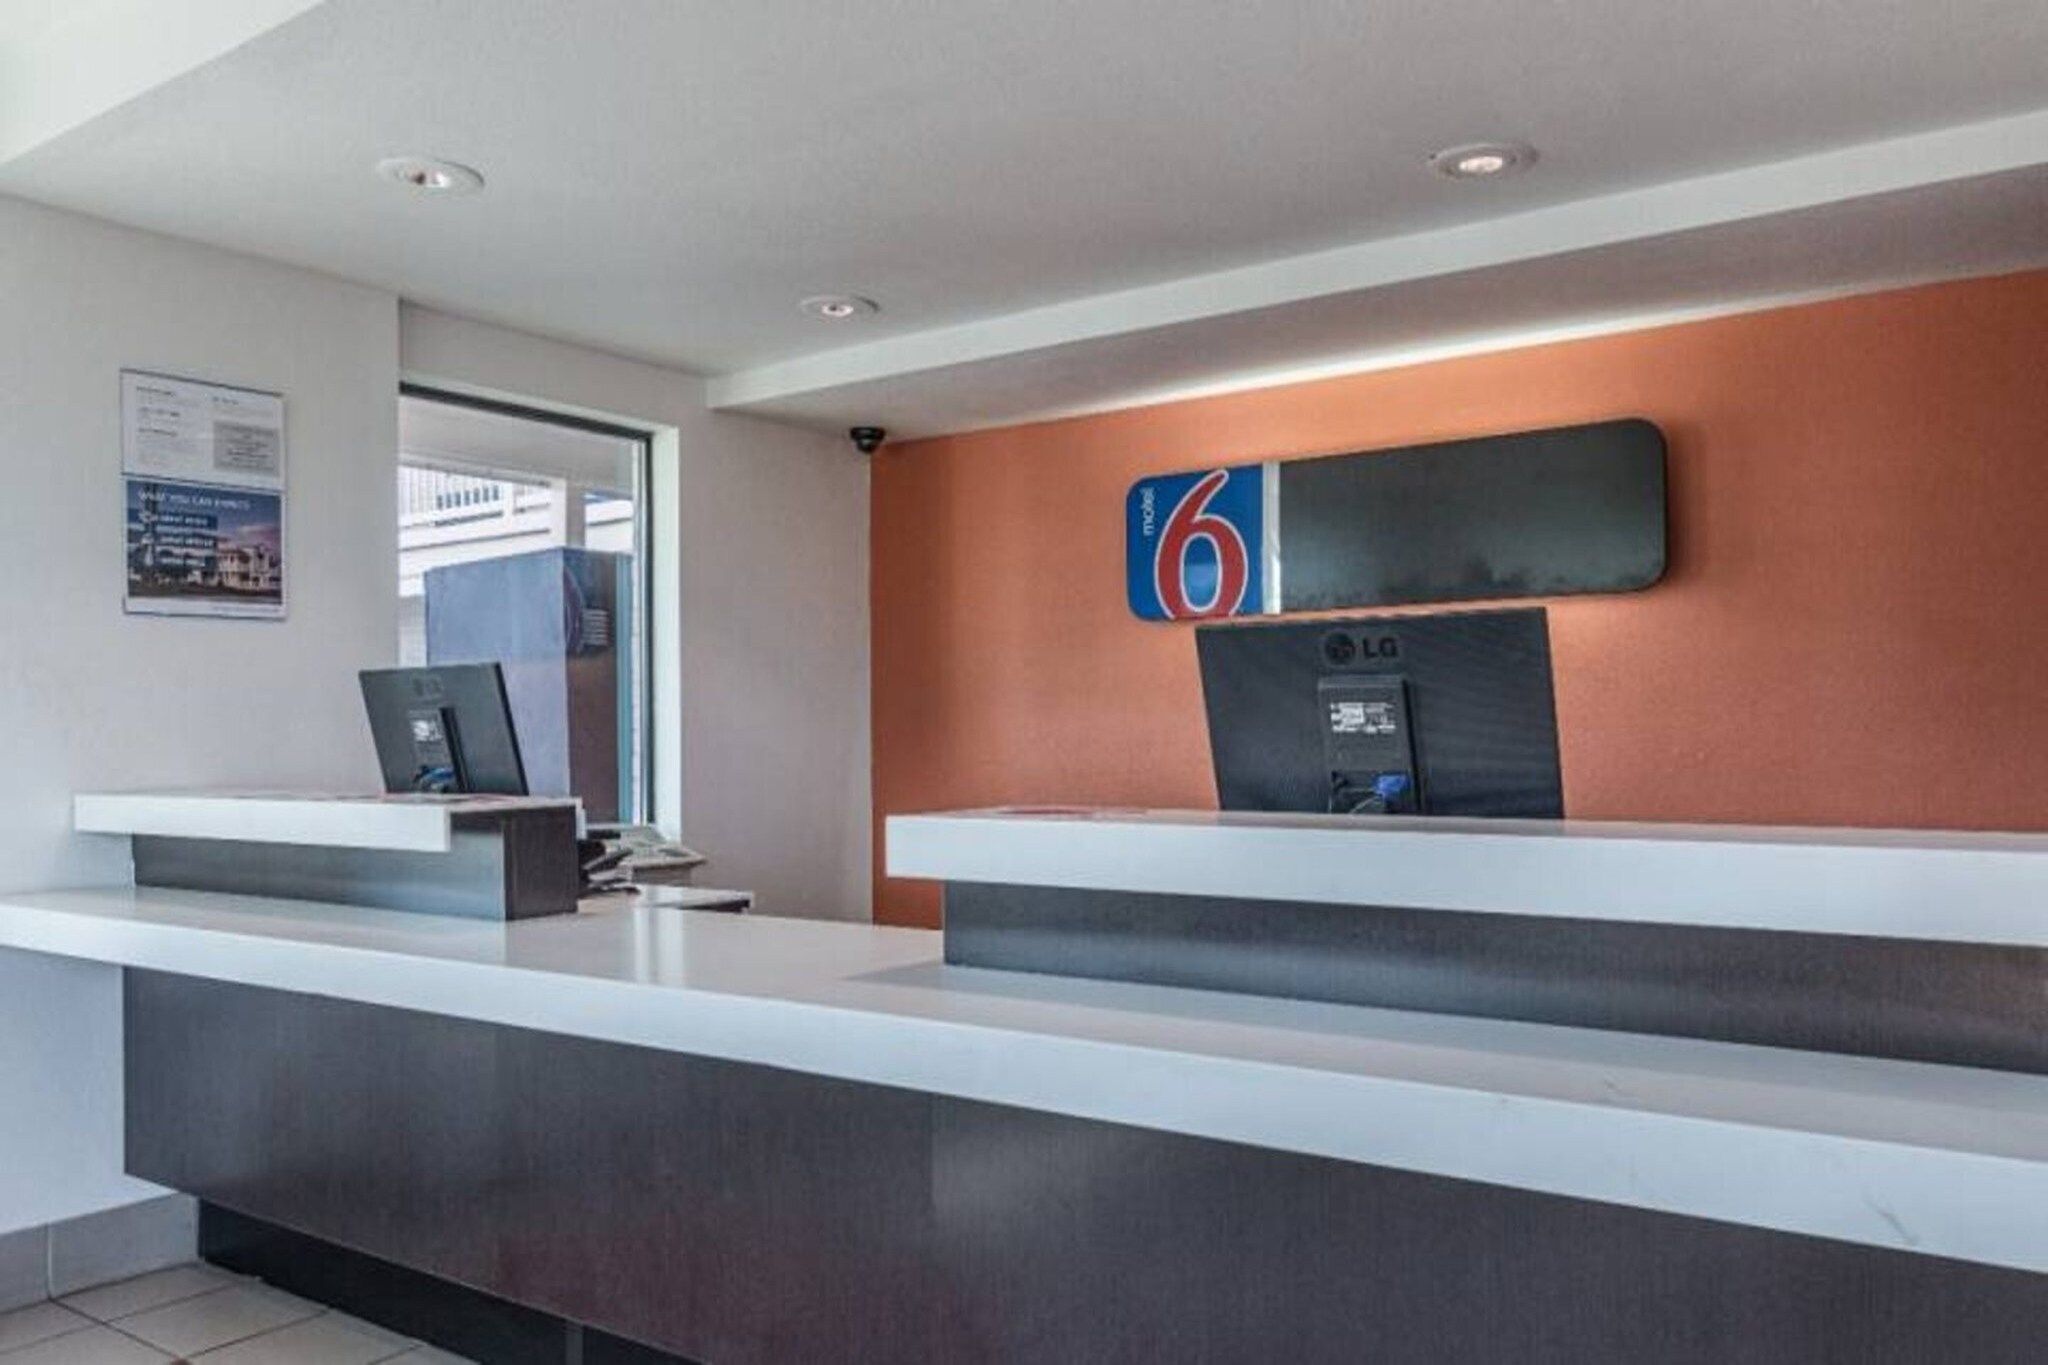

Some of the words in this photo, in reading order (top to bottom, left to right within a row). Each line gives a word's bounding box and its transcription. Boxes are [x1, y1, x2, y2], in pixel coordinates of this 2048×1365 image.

[192, 494, 212, 506] CAN
[1140, 487, 1156, 536] motel
[1154, 469, 1248, 620] 6
[1363, 637, 1398, 659] LG
